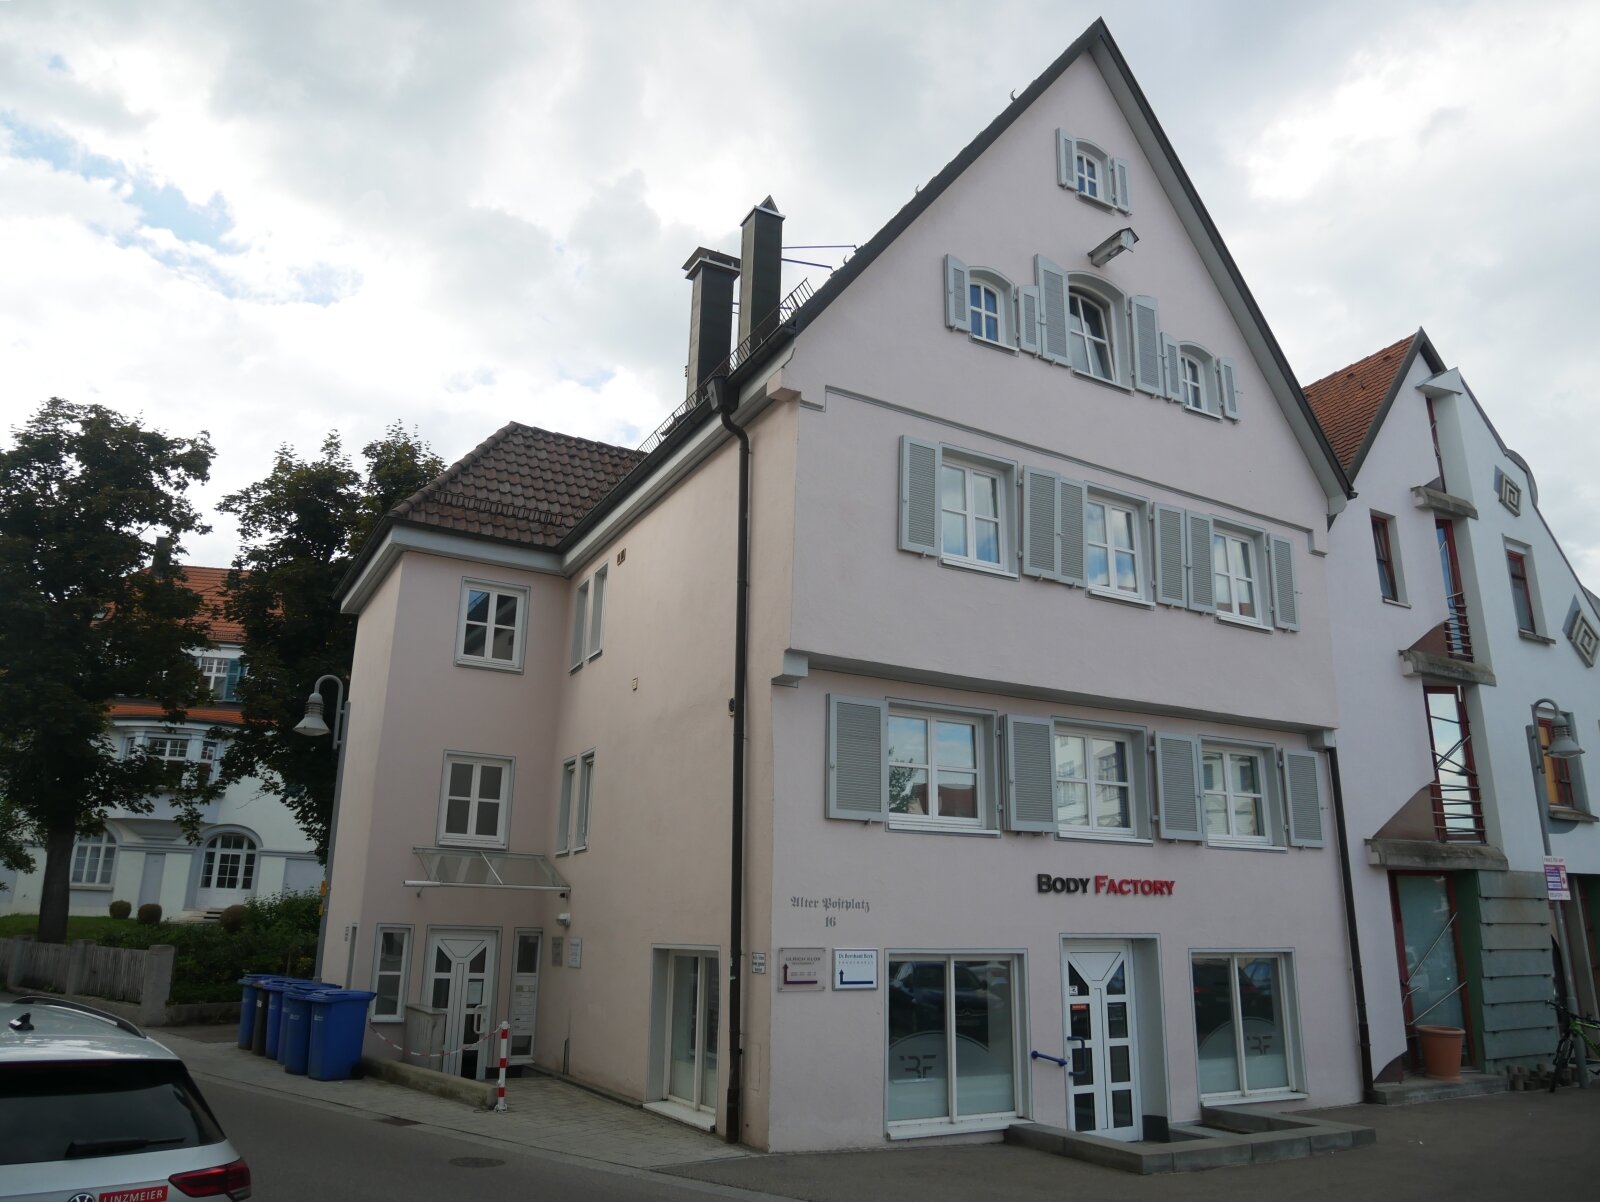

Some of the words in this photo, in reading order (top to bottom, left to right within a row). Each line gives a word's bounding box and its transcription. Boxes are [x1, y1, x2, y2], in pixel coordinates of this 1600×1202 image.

[1037, 873, 1090, 894] BODY
[1095, 875, 1176, 896] FACTORY
[790, 896, 819, 909] Alter
[825, 916, 837, 928] 16
[103, 1189, 164, 1202] LINZMEIER
